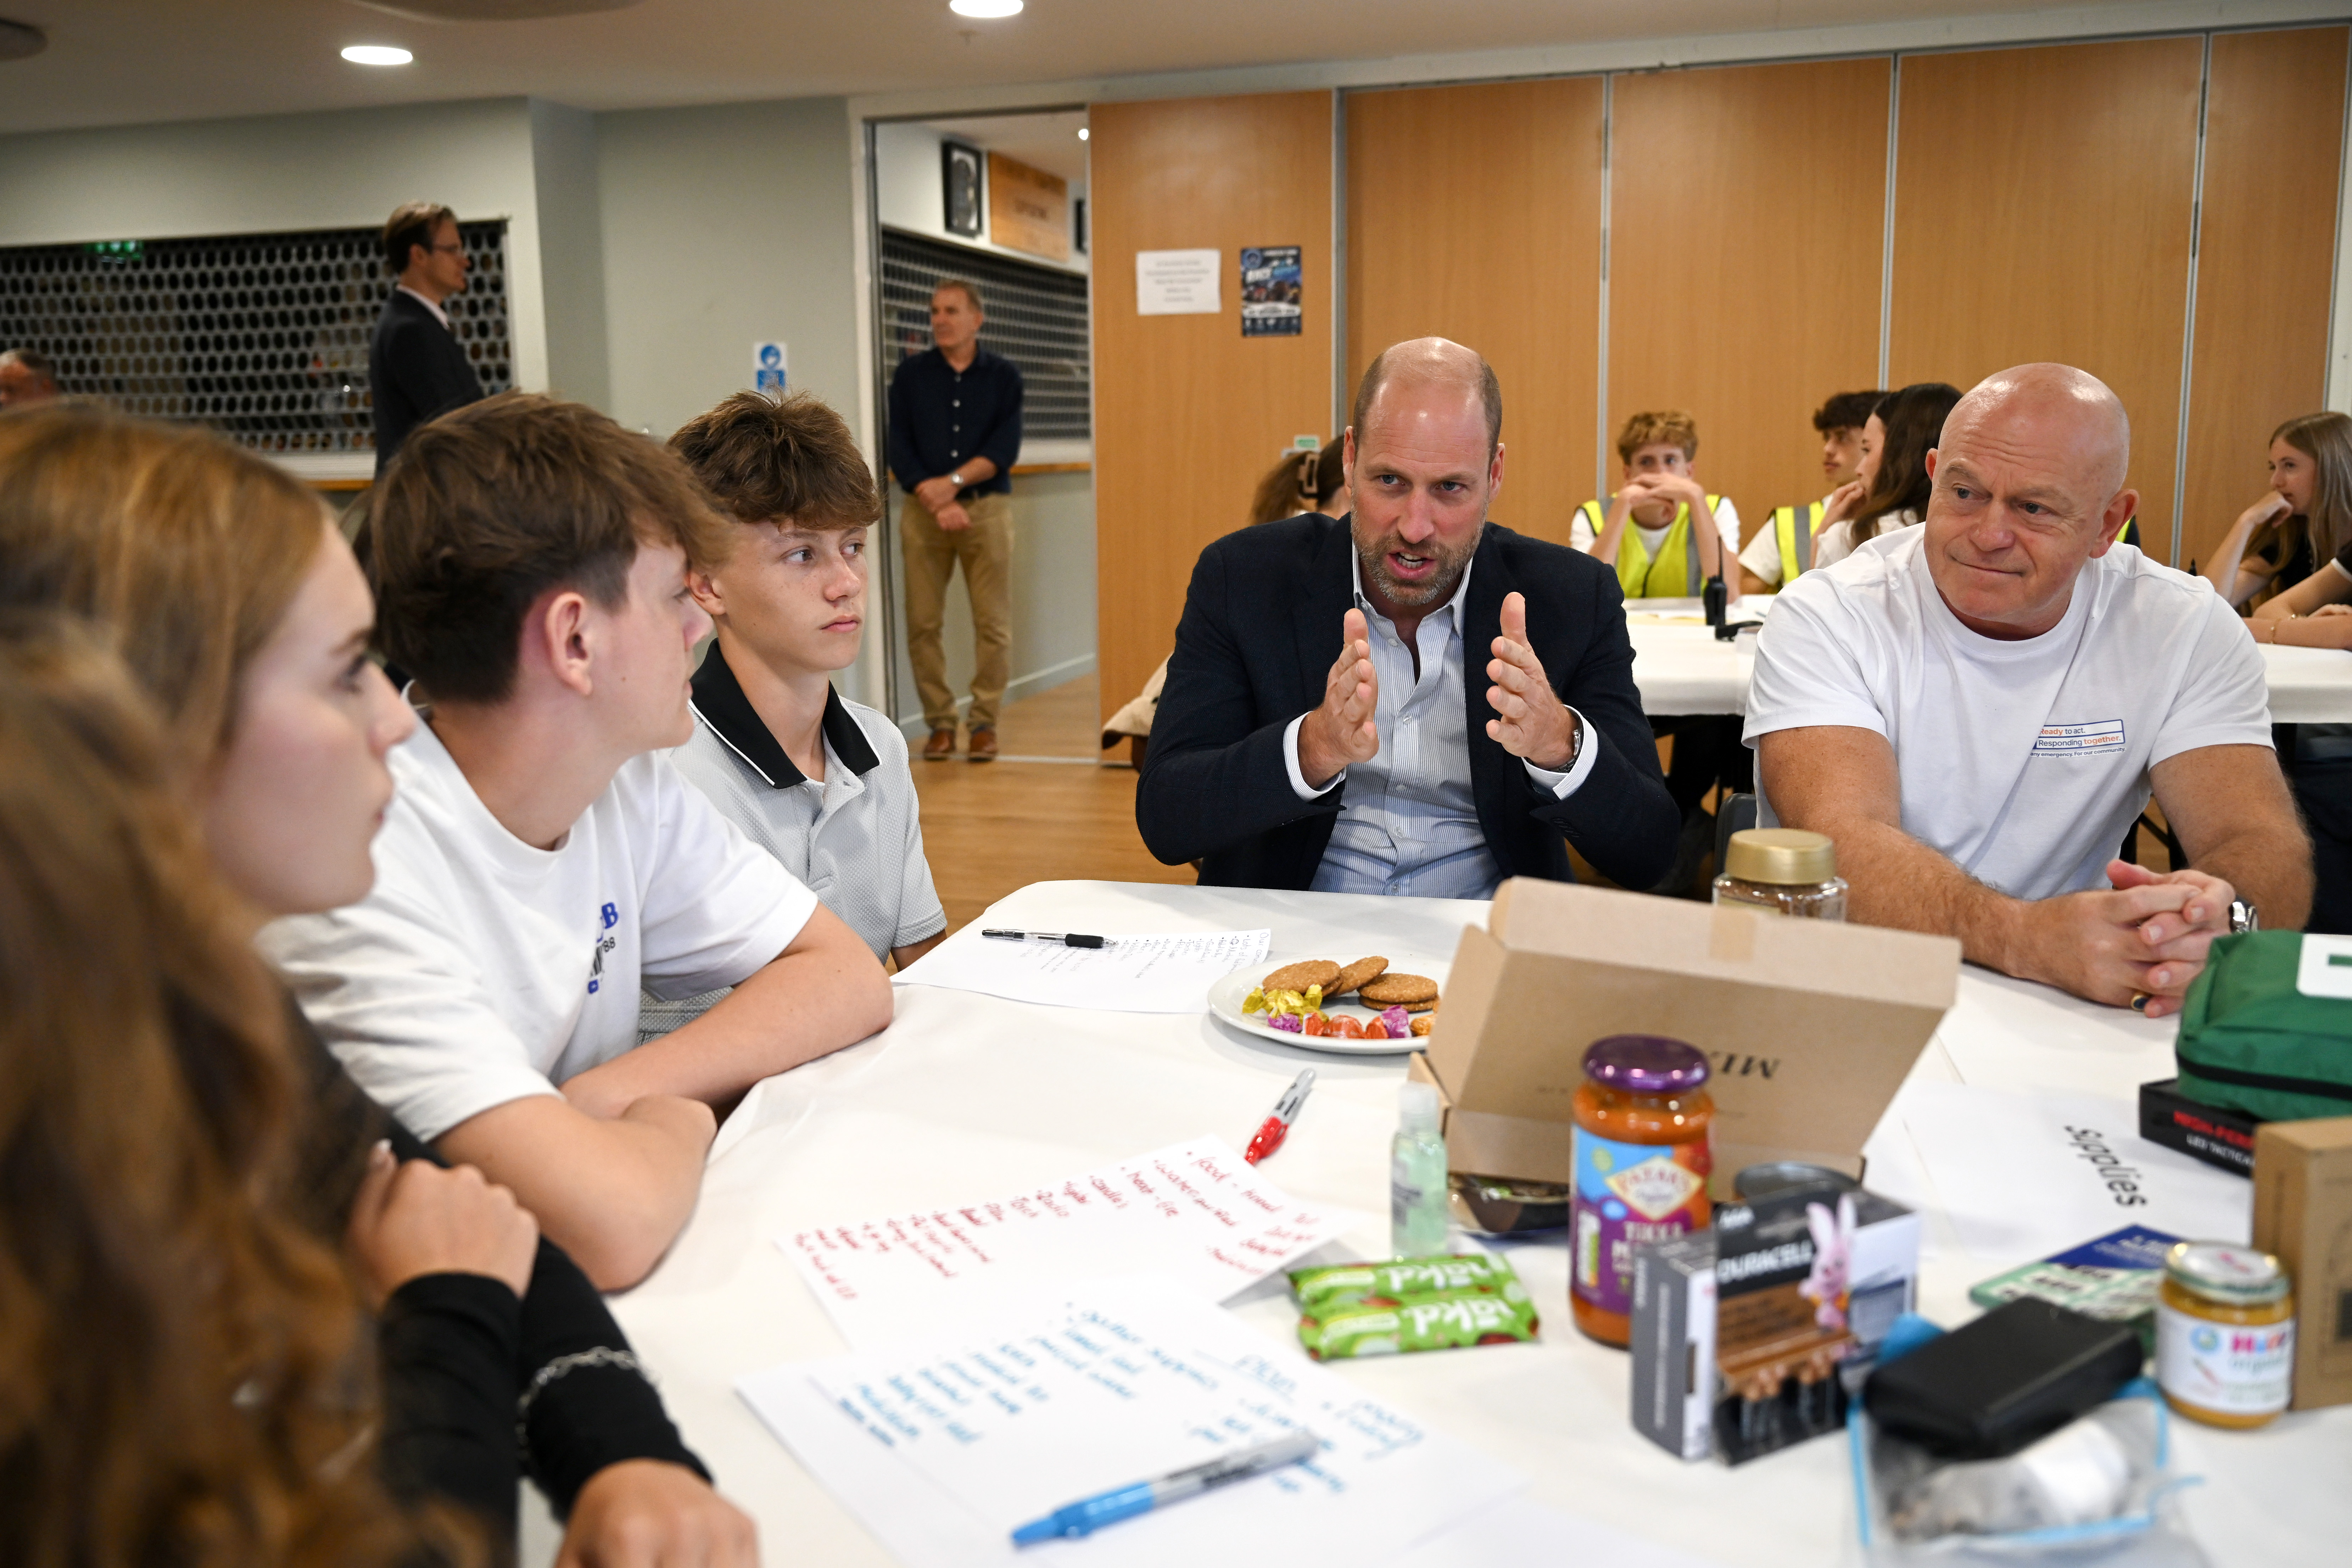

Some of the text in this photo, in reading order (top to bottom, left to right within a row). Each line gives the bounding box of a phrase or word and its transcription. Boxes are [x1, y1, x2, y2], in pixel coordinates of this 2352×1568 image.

[2039, 736, 2121, 747] Responding together.
[1240, 939, 1252, 950] Lots
[1258, 932, 1269, 946] Our
[1190, 1156, 1231, 1183] food
[2064, 1125, 2147, 1207] supplies
[1716, 1239, 1812, 1285] DURACELL
